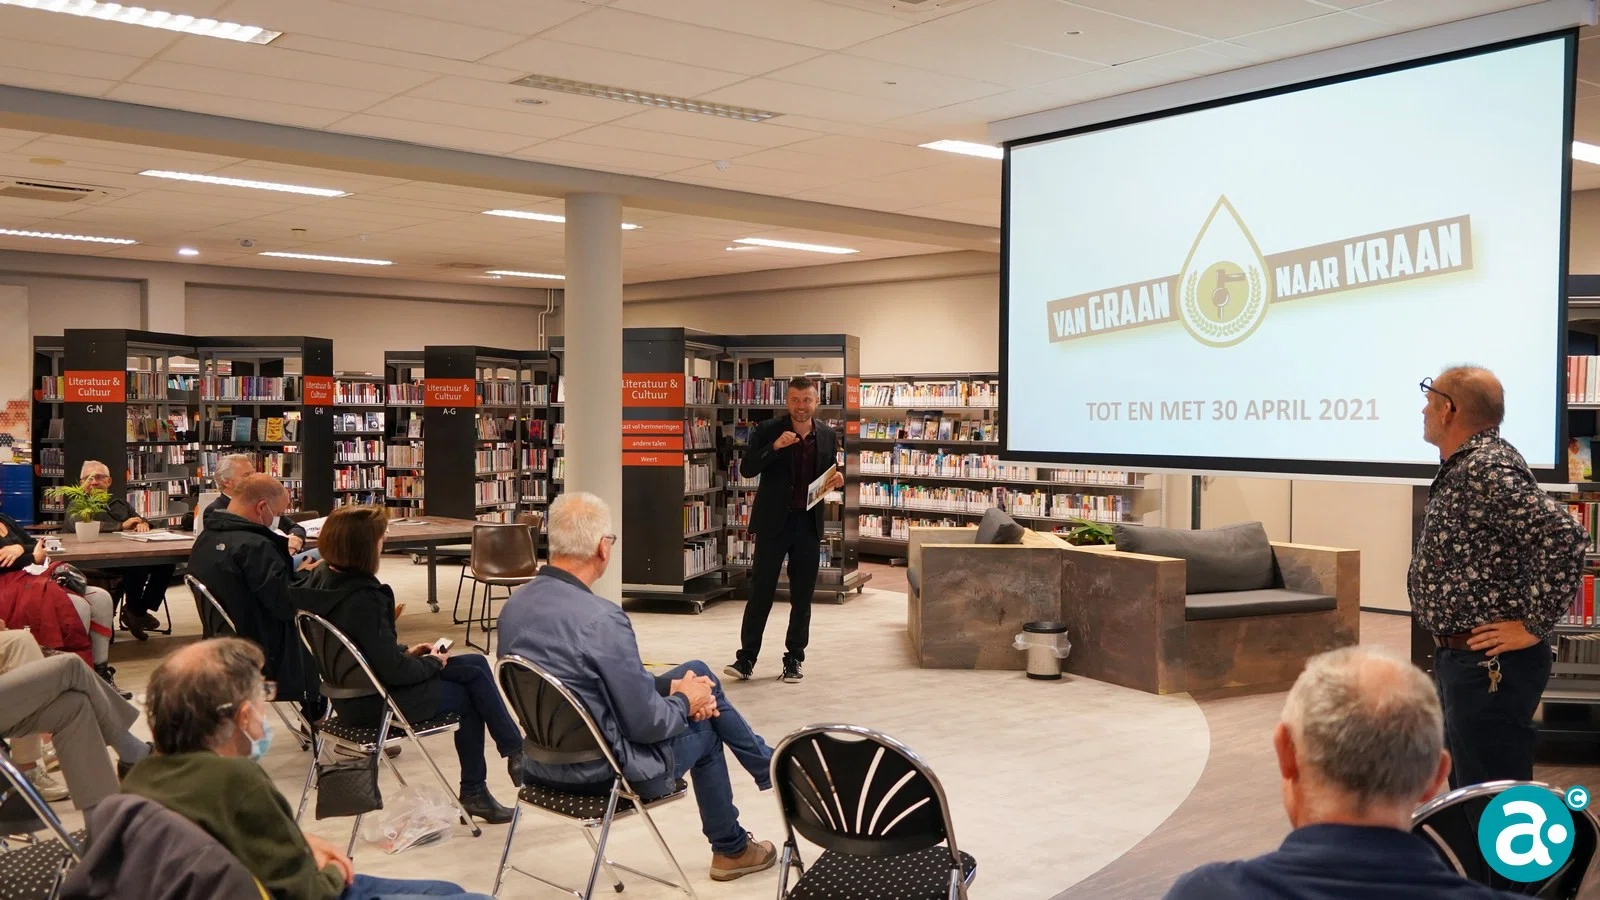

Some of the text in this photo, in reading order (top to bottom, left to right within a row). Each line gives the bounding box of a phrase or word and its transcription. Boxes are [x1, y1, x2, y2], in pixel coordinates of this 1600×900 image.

[1053, 222, 1463, 338] VAN GRAAN NAAR KRAAN
[68, 376, 120, 386] Literatuur &
[621, 378, 678, 389] Literatuur &
[78, 387, 111, 397] Cultuur
[427, 384, 470, 392] Literatuur &
[434, 392, 462, 400] Cultuur
[631, 390, 668, 400] Cultuur
[86, 404, 103, 413] G-N
[442, 407, 457, 415] A-G
[1086, 398, 1380, 421] TOT EN MET 30 APRIL 2021
[641, 423, 680, 431] herinneringen
